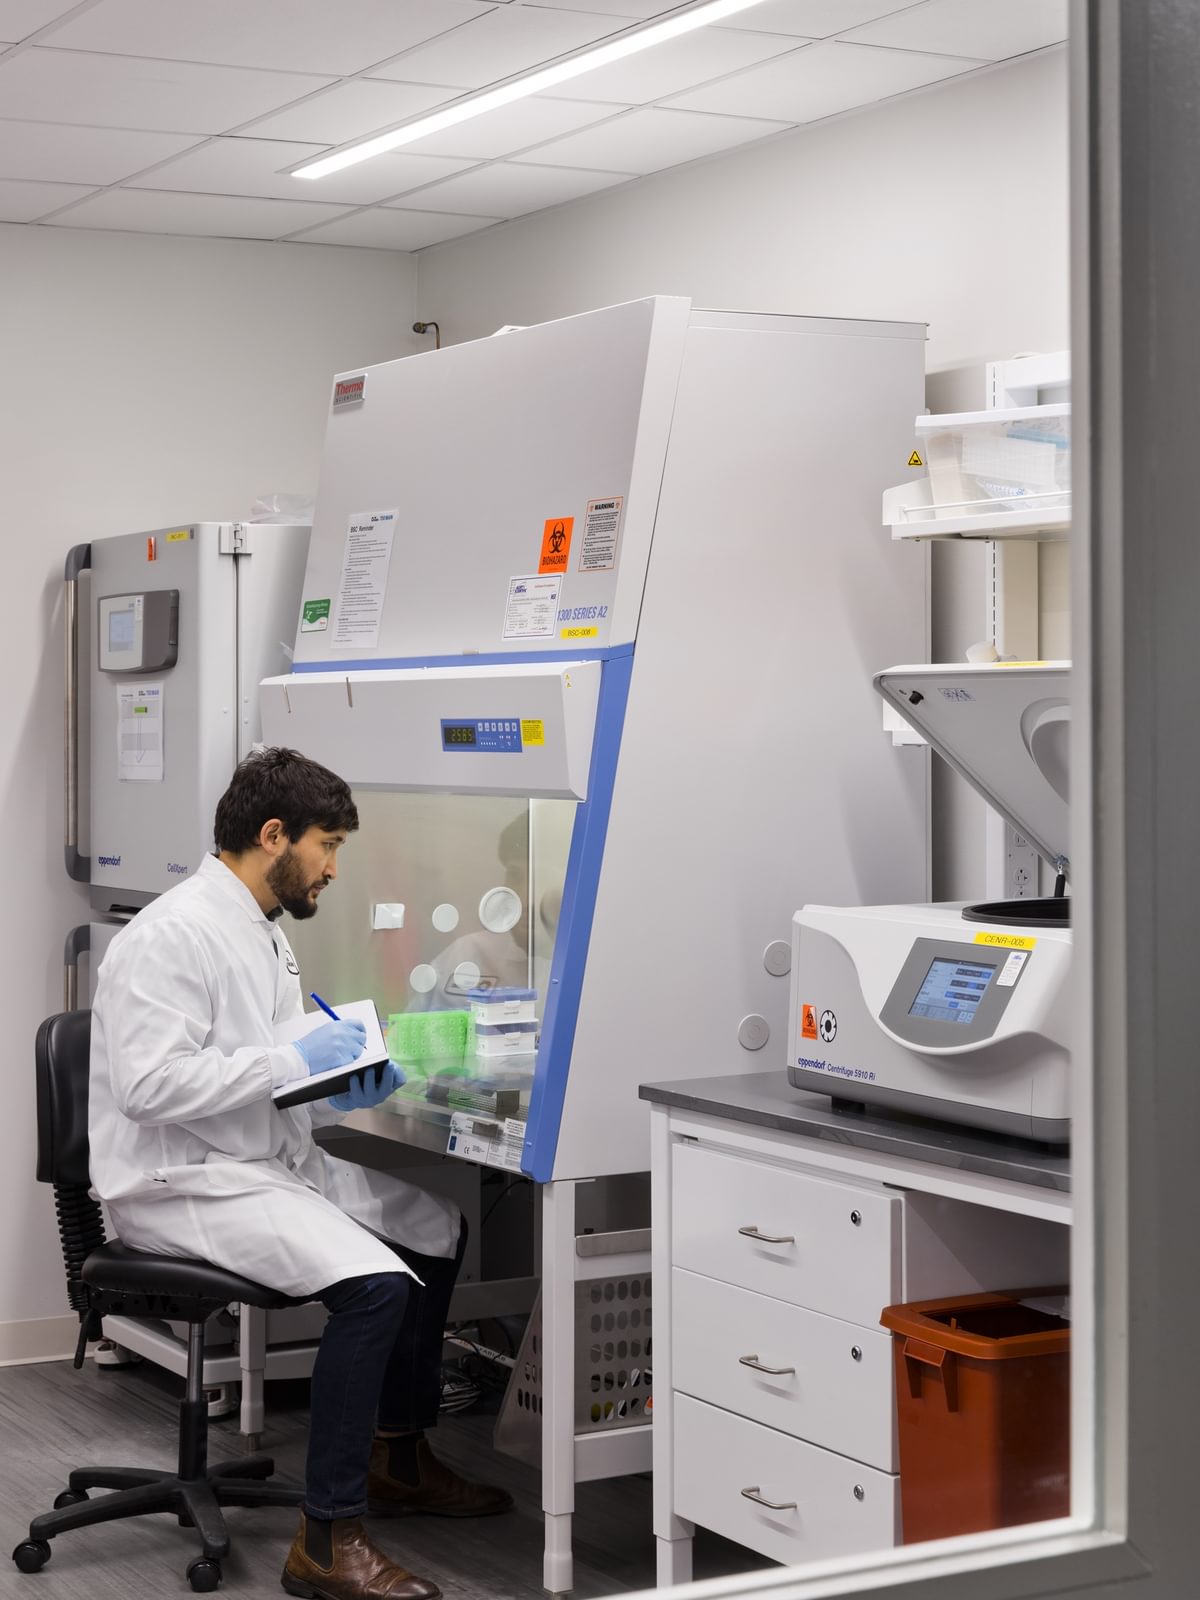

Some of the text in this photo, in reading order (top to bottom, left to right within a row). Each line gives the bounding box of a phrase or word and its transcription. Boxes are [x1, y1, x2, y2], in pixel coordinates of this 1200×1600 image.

[336, 381, 364, 396] Thermo
[594, 502, 615, 510] WARNING
[542, 555, 567, 566] BIOHAZARD
[557, 605, 608, 621] 1300 SERIES A2
[798, 1057, 826, 1070] eppendorf
[827, 1063, 854, 1077] Centrifuge
[854, 1069, 868, 1079] 5910
